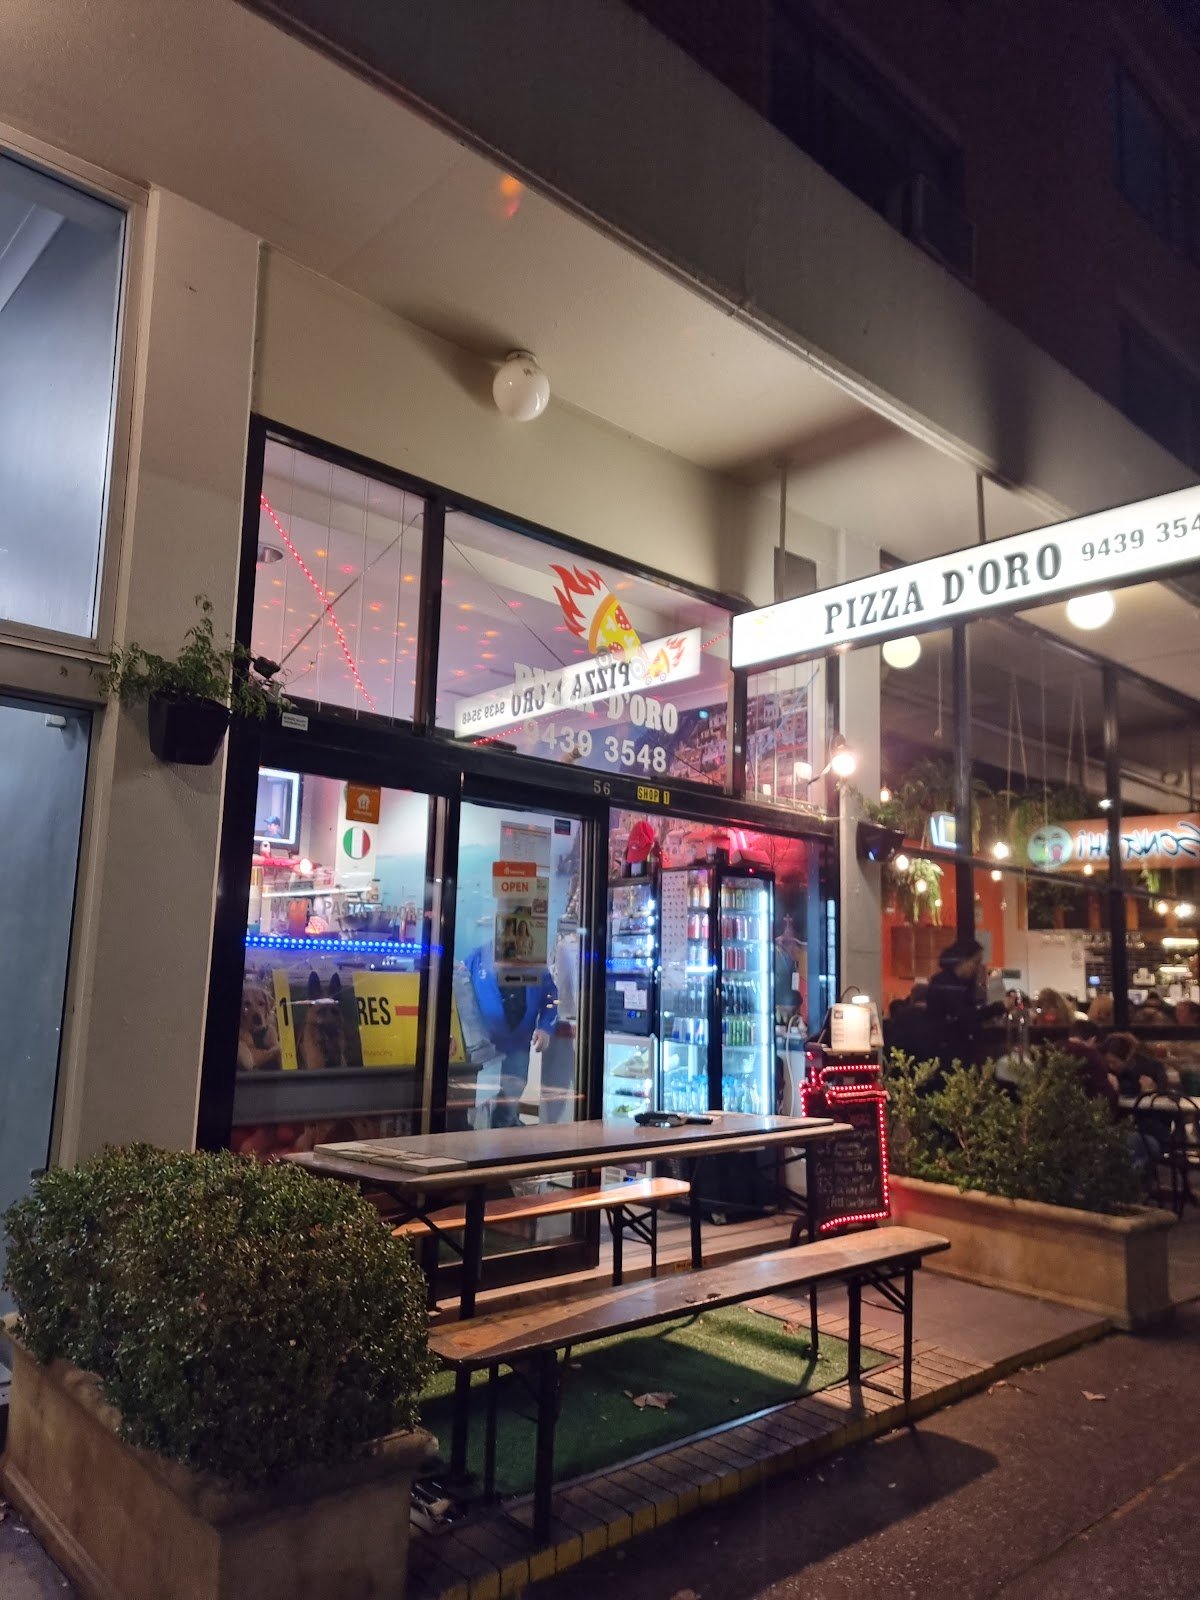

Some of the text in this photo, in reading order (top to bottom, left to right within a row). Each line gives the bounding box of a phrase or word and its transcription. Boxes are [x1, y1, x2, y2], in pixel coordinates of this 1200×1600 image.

[823, 580, 925, 635] PIZZA
[942, 543, 1063, 606] D'ORO
[1081, 528, 1145, 562] 9439
[607, 694, 678, 735] D'ORO
[523, 718, 667, 772] 9439 3548
[593, 780, 611, 795] 56
[637, 786, 660, 803] SHOP
[501, 880, 529, 893] OPEN
